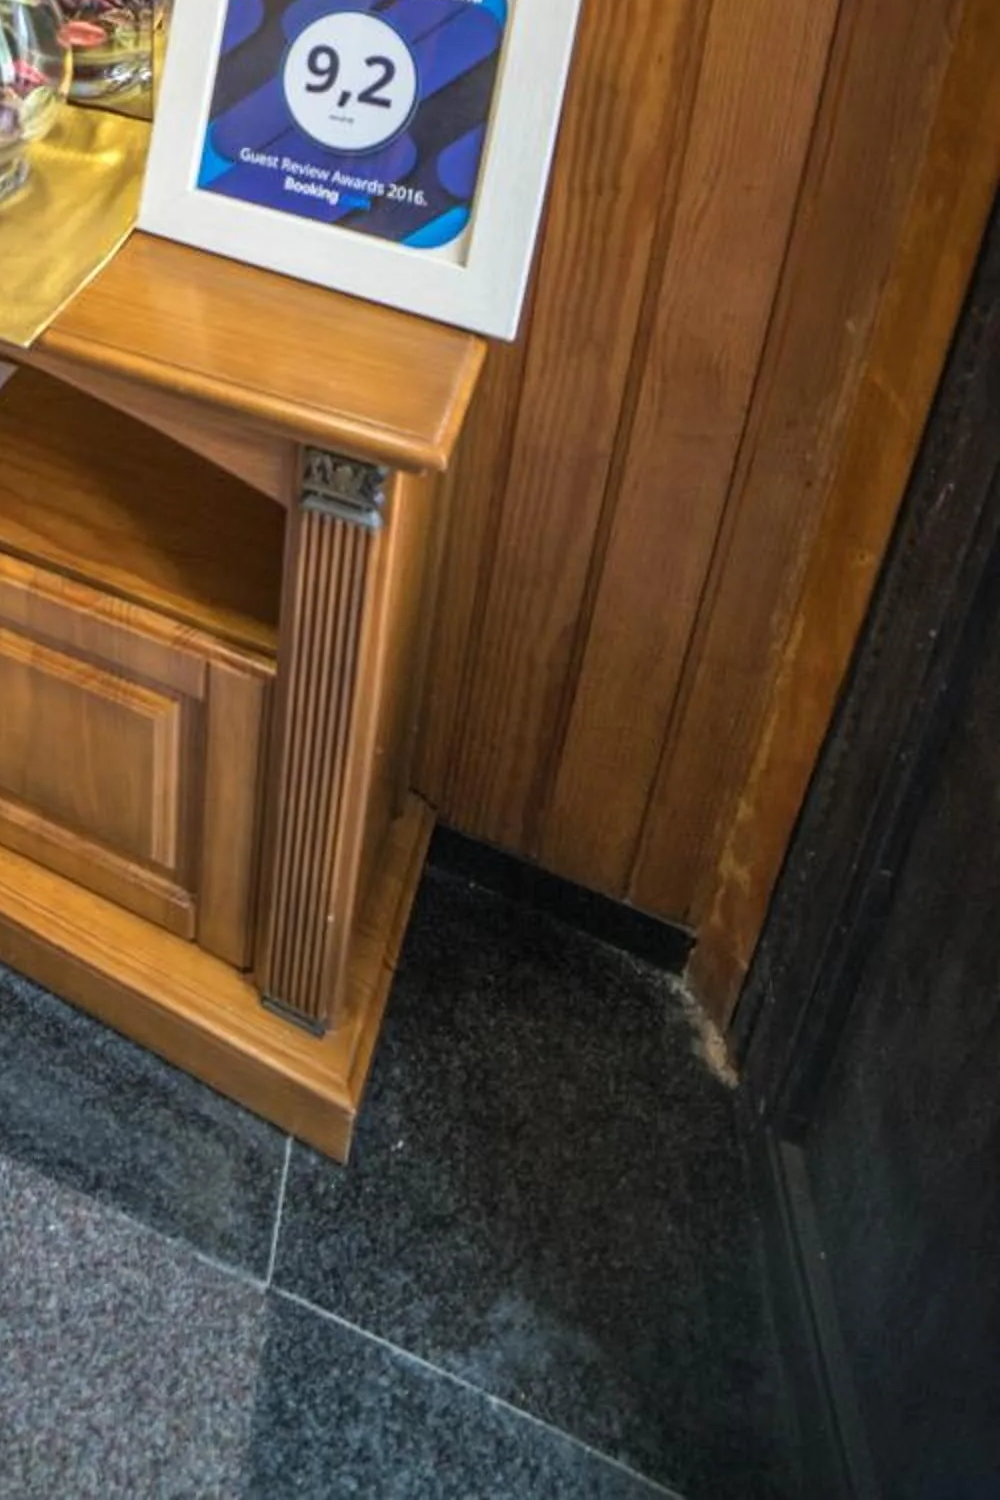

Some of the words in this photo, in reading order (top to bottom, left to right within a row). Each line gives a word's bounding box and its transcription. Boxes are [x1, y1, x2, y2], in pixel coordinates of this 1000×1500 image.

[304, 44, 397, 109] 9,2
[239, 147, 279, 169] Guest
[281, 157, 331, 182] Review
[331, 169, 385, 197] Awards
